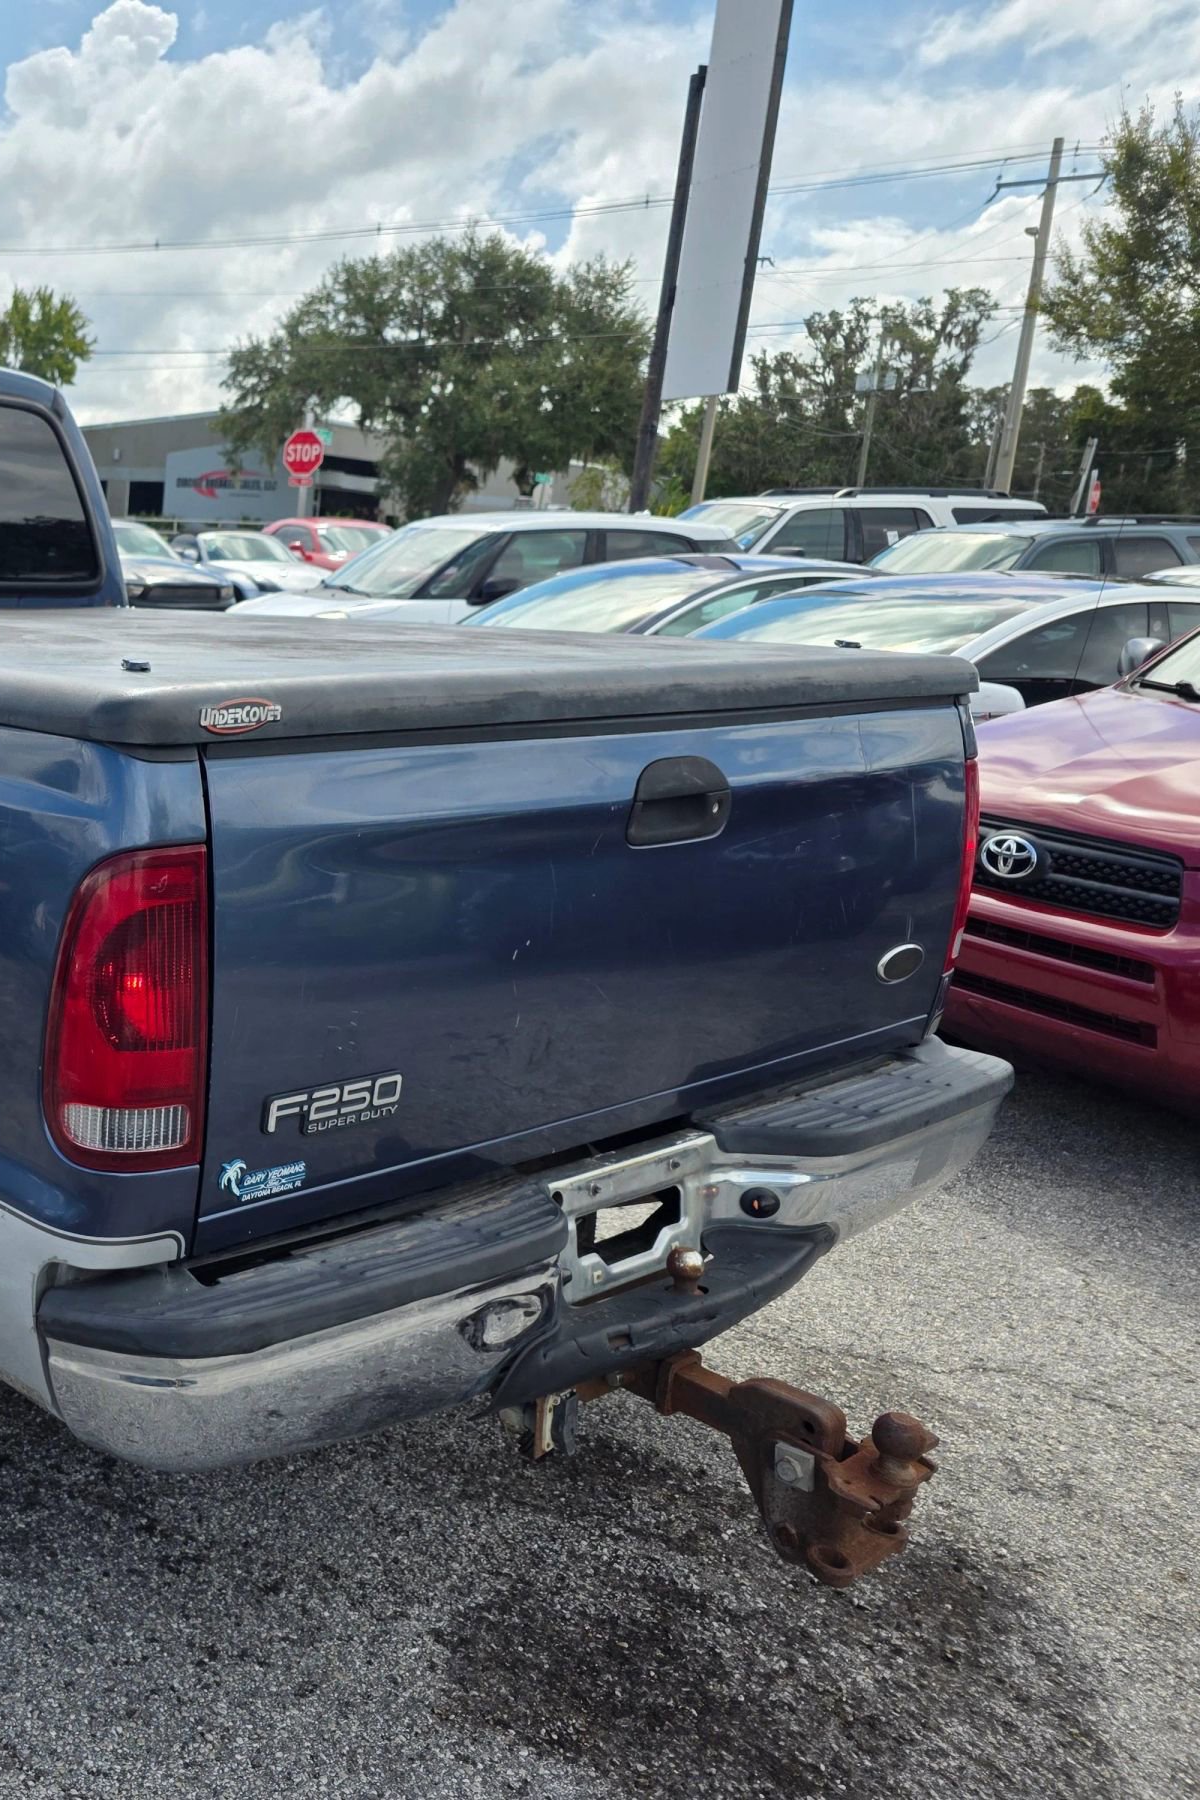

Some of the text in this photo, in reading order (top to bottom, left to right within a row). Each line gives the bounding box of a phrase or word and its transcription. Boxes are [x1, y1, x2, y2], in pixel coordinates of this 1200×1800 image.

[286, 443, 321, 463] STOP
[307, 1104, 399, 1133] SUPER DUTY
[243, 1171, 267, 1186] GARY
[241, 1188, 271, 1202] DAYTONA
